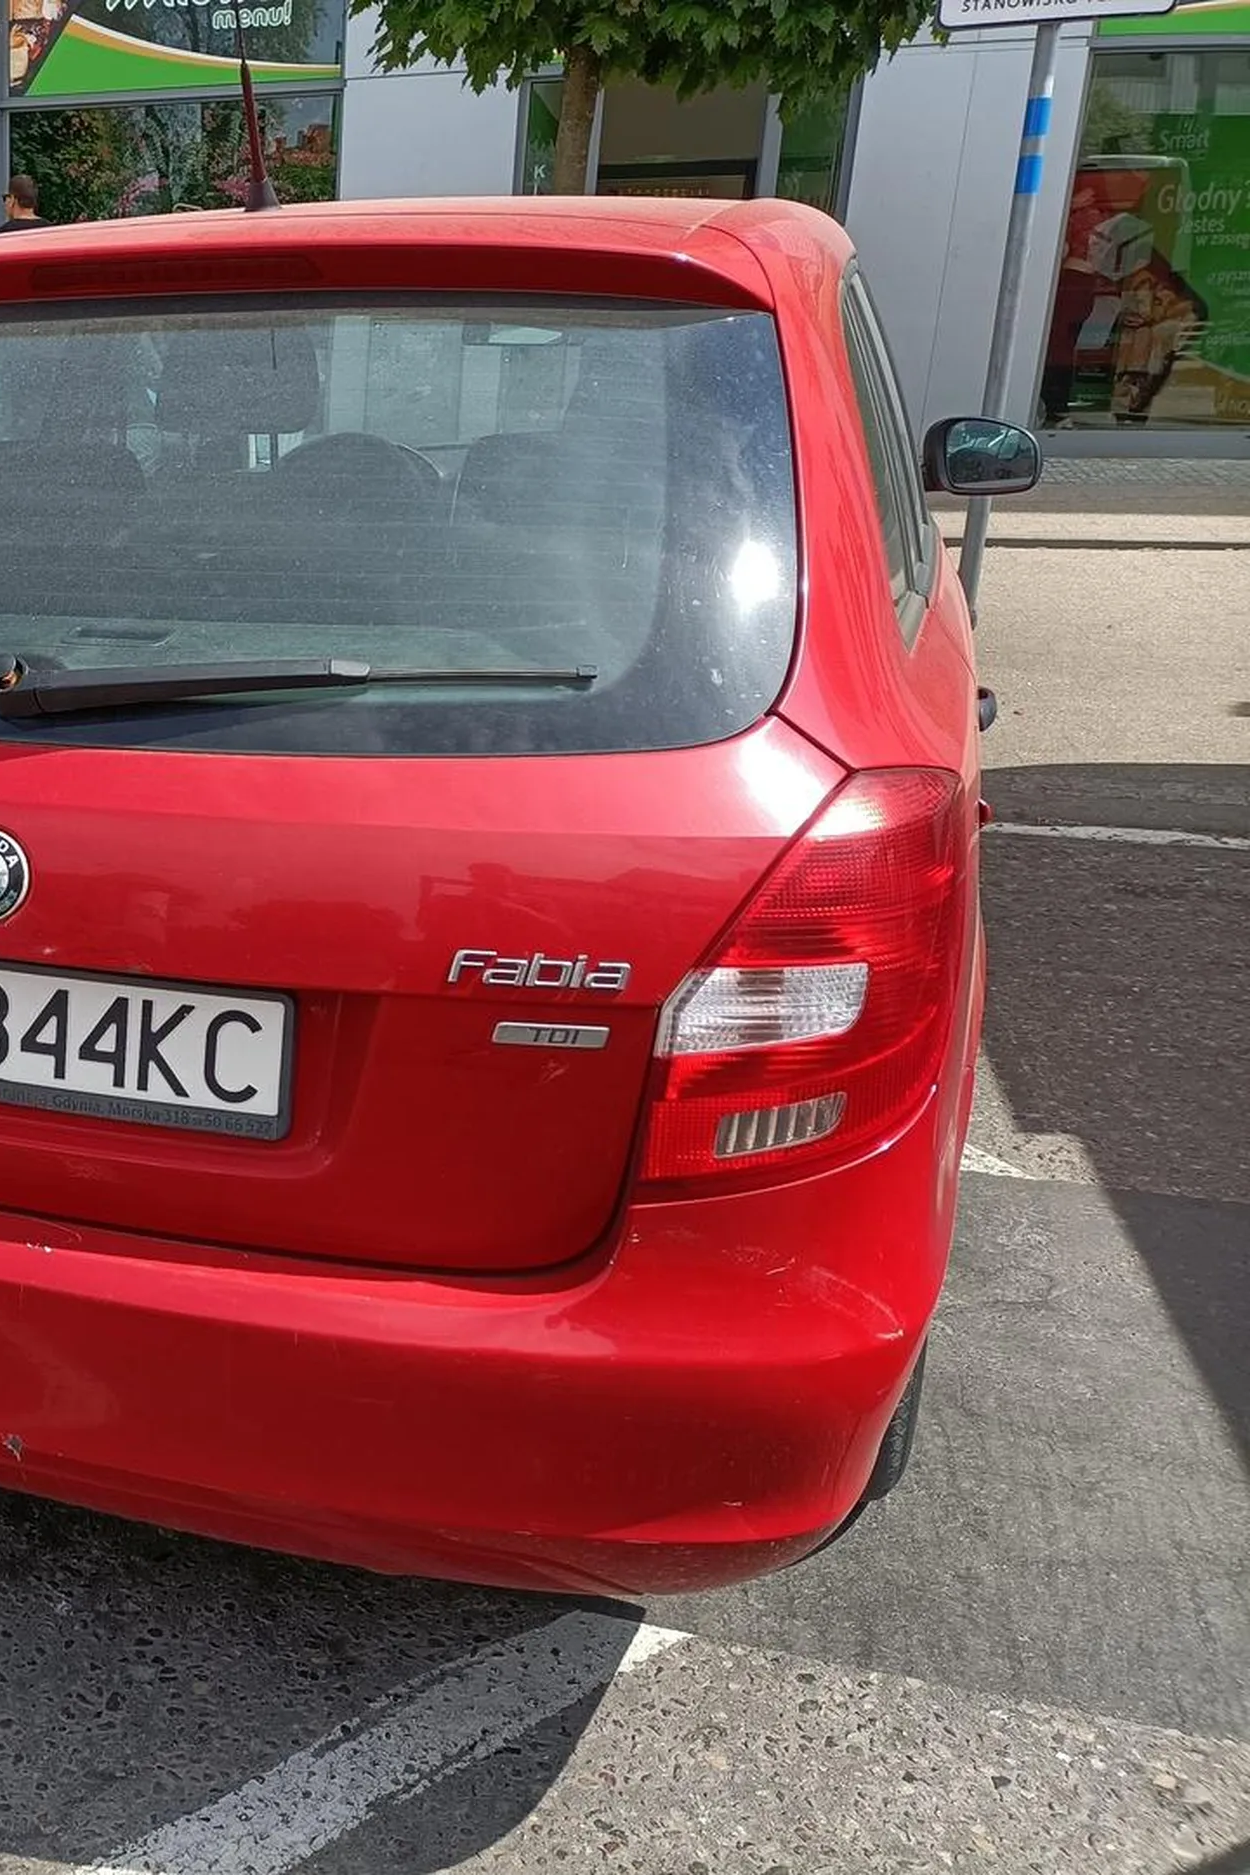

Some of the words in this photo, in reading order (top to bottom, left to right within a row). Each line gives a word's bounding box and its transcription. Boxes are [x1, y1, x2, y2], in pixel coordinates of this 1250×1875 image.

[447, 949, 631, 990] Fabia
[528, 1027, 581, 1045] TDI
[163, 1108, 191, 1126] 318
